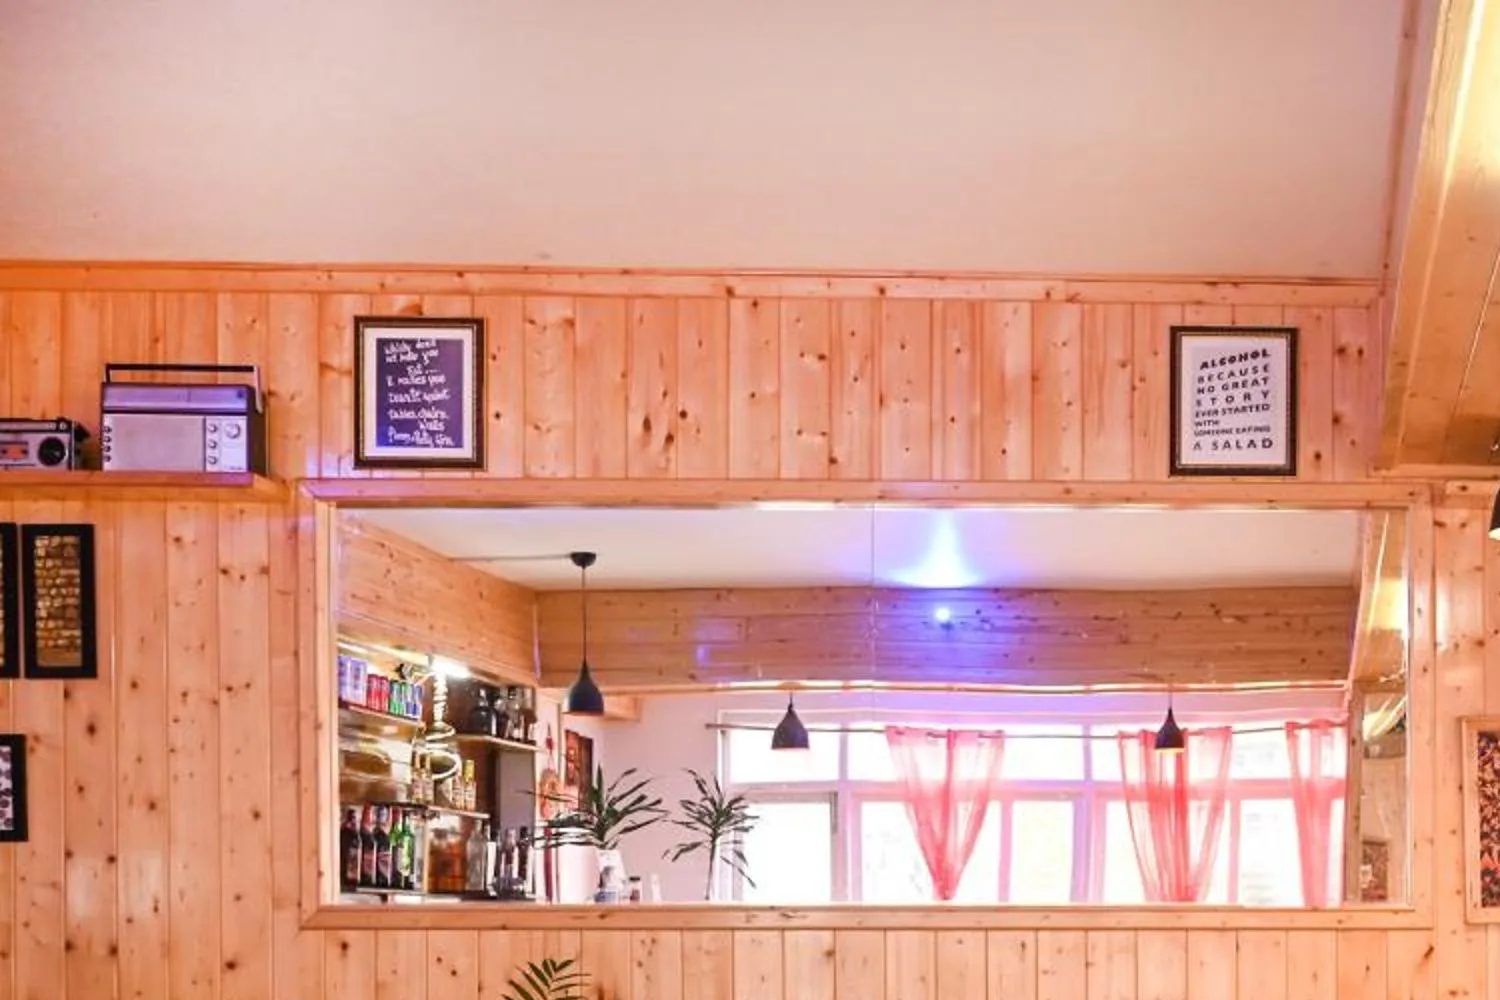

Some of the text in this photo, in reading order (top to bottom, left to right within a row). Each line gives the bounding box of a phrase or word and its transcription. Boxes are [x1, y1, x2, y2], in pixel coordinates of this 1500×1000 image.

[1200, 348, 1271, 370] ALCOHOL
[1198, 363, 1269, 384] BECAUSE
[1197, 376, 1269, 395] NO GREAT
[1196, 390, 1270, 407] STORY
[1195, 404, 1271, 418] EVER STARTED
[1193, 438, 1273, 451] A SALAD
